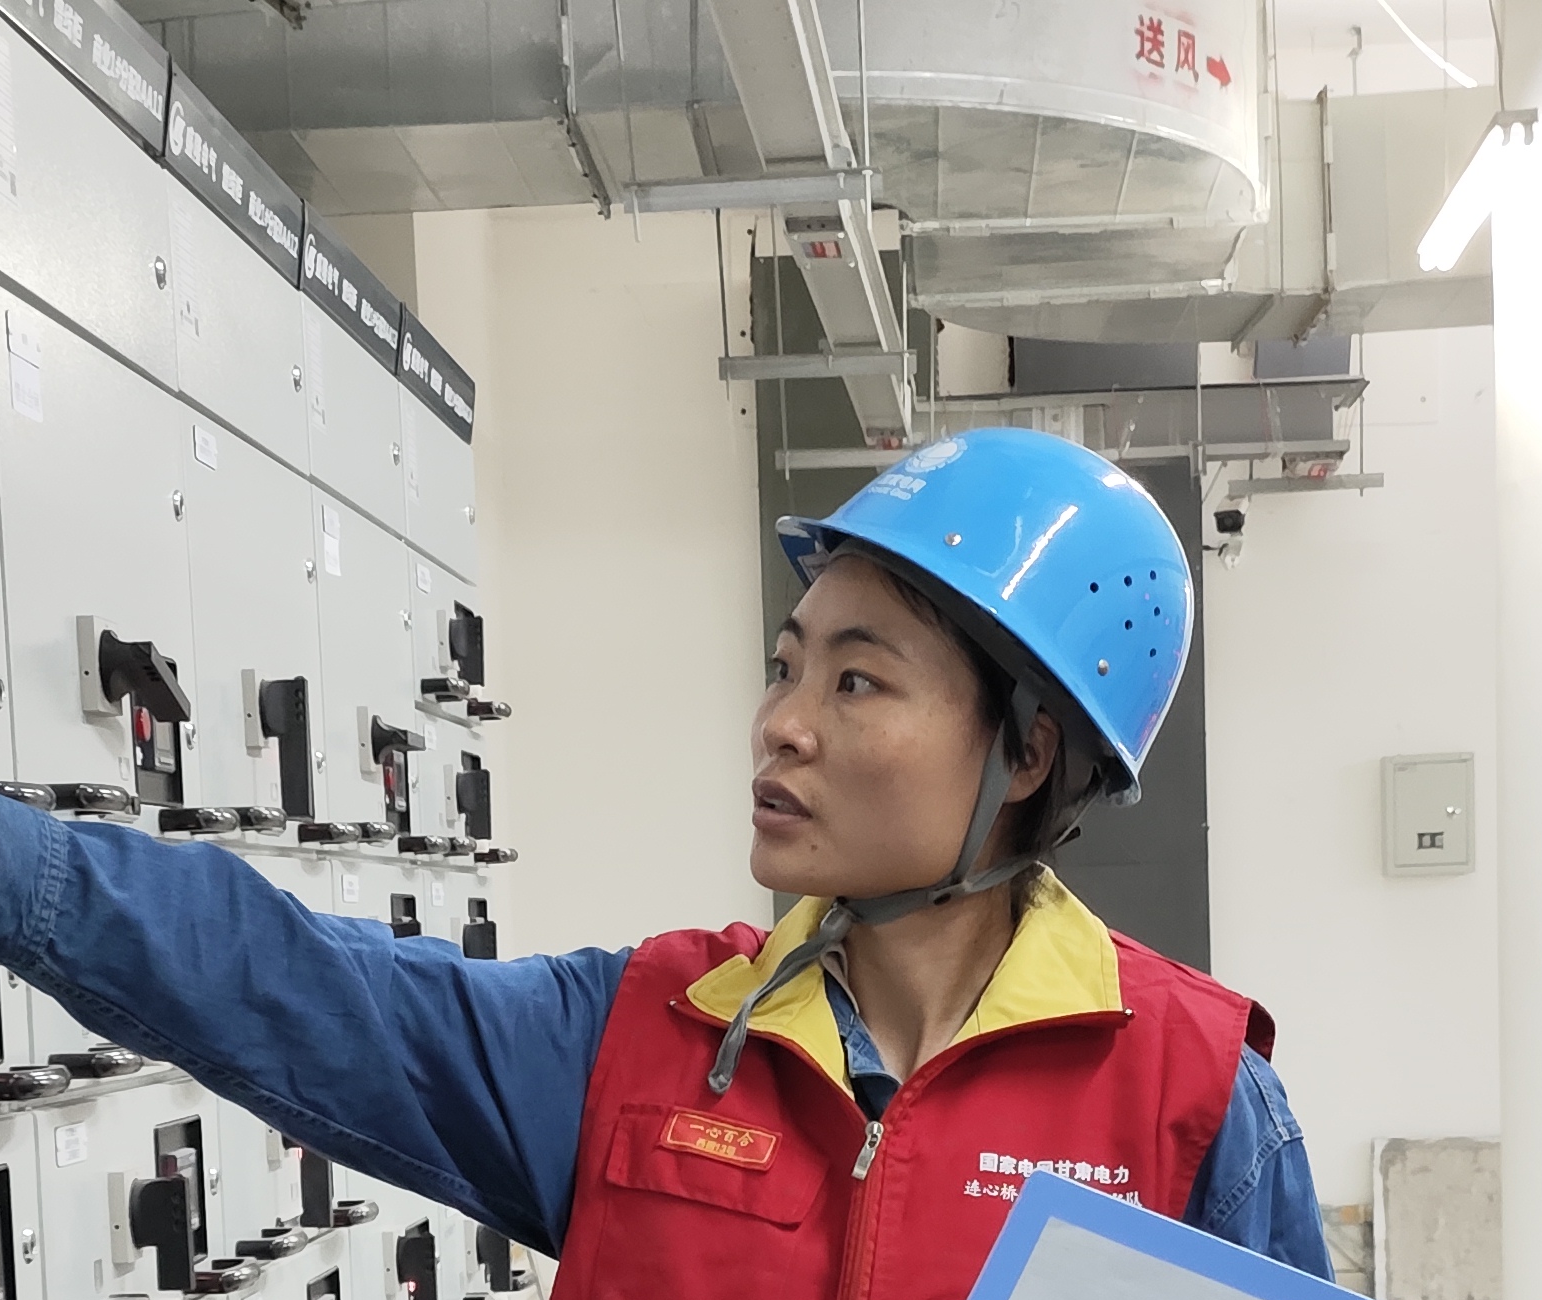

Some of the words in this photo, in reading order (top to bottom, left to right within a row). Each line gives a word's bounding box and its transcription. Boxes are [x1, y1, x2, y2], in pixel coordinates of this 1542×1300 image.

[1135, 14, 1200, 83] 送风
[689, 1123, 755, 1147] 一心百合
